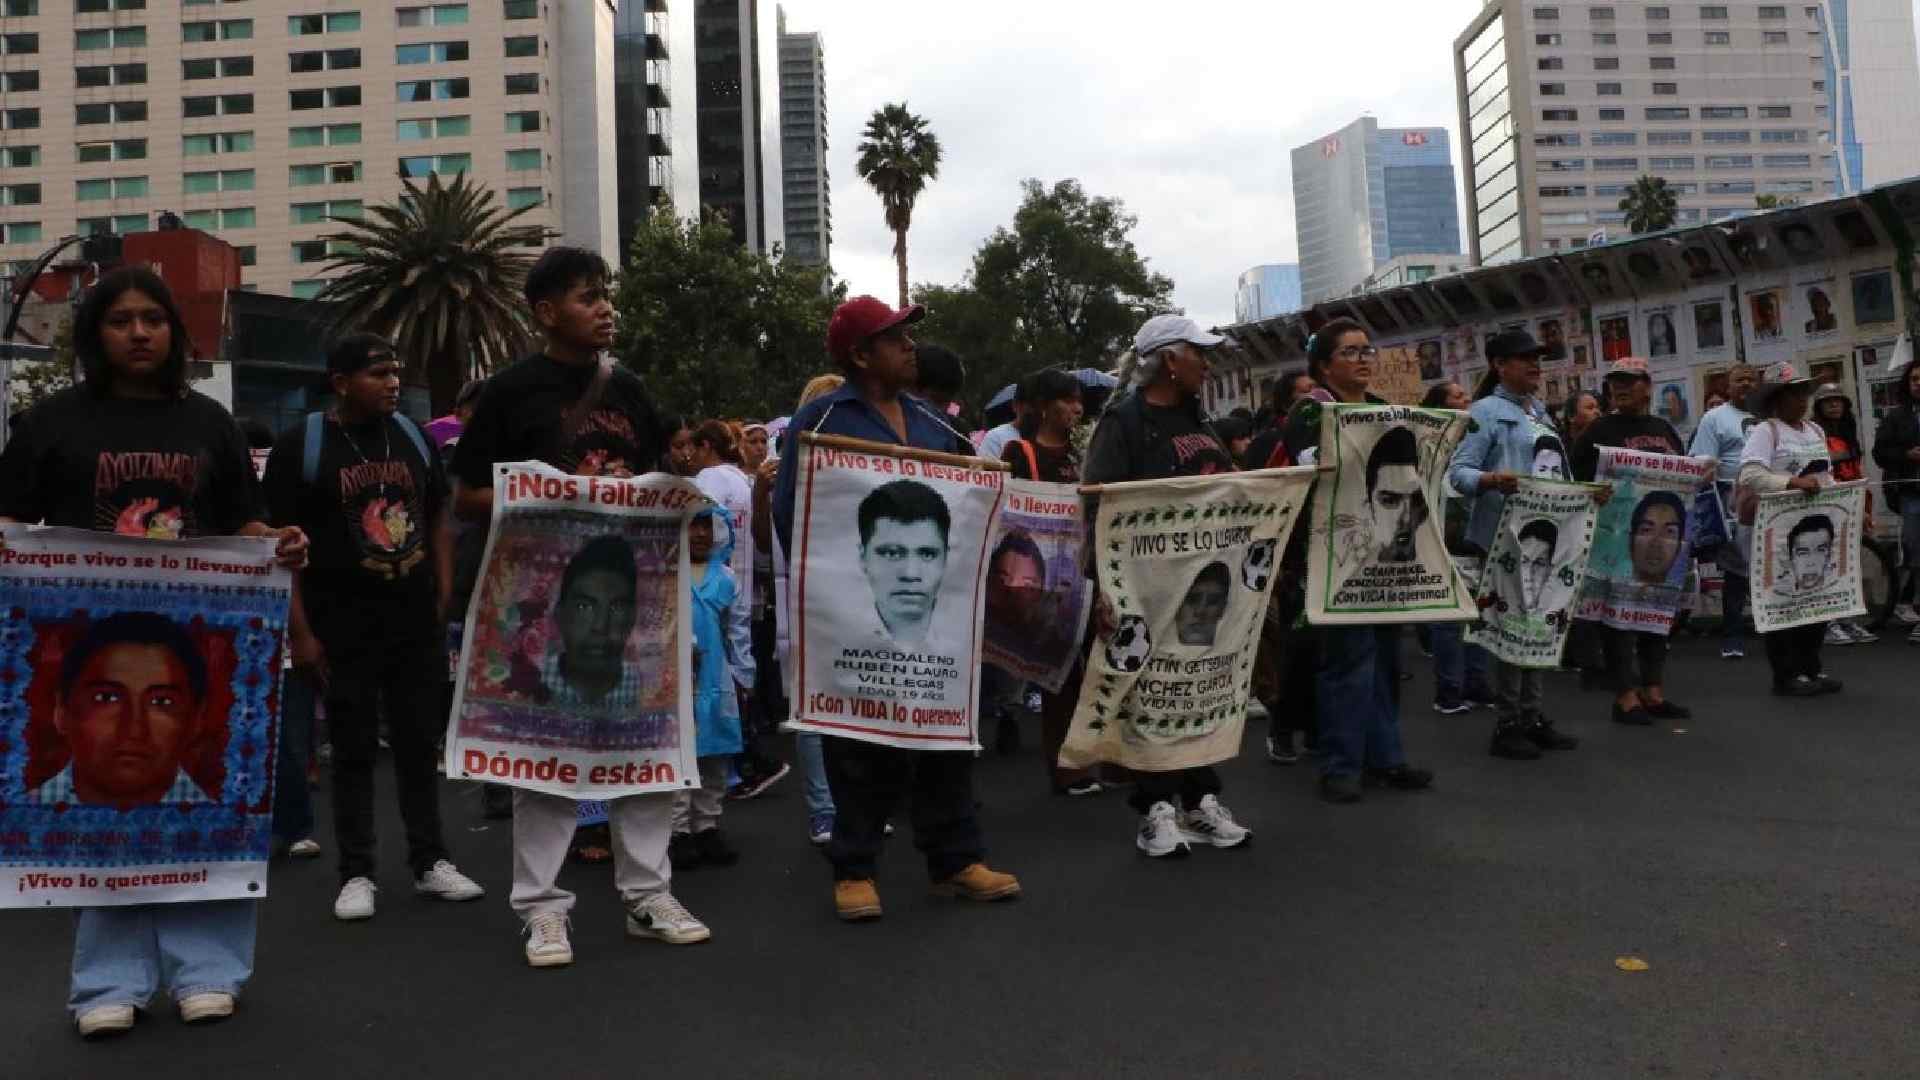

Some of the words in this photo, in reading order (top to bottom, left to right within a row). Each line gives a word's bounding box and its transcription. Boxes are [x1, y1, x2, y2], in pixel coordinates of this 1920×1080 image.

[1377, 411, 1391, 422] se
[816, 448, 868, 473] ¡Vivo
[872, 460, 894, 475] se
[900, 459, 916, 477] lo
[921, 461, 1000, 489] llevaron!
[1608, 453, 1642, 467] ¡Vivo
[1647, 458, 1659, 469] se
[1663, 457, 1673, 471] lo
[508, 472, 578, 502] ¡Nos
[588, 478, 657, 507] faltan
[1009, 494, 1020, 511] lo
[1131, 533, 1166, 557] ¡VIVO
[1172, 532, 1189, 553] SE
[1194, 531, 1212, 552] LO
[4, 549, 77, 568] Porque
[83, 550, 127, 569] vivo
[133, 556, 155, 569] se
[161, 551, 179, 570] lo
[186, 555, 273, 577] llevaron!
[1621, 608, 1631, 620] lo
[842, 648, 955, 666] MAGDALENO
[857, 672, 945, 690] VILLEGAS
[913, 666, 959, 680] LAURO
[857, 685, 897, 699] EDAD
[902, 689, 917, 700] 19
[810, 692, 844, 715] ¡Con
[851, 698, 888, 720] VIDA
[892, 702, 908, 725] lo
[912, 706, 967, 729] queremos!
[1140, 697, 1177, 711] VIDA
[1183, 698, 1194, 712] lo
[464, 748, 578, 785] Dónde
[589, 759, 675, 785] están
[19, 872, 73, 892] ¡Vivo
[79, 872, 98, 889] lo
[104, 869, 208, 891] queremos!
